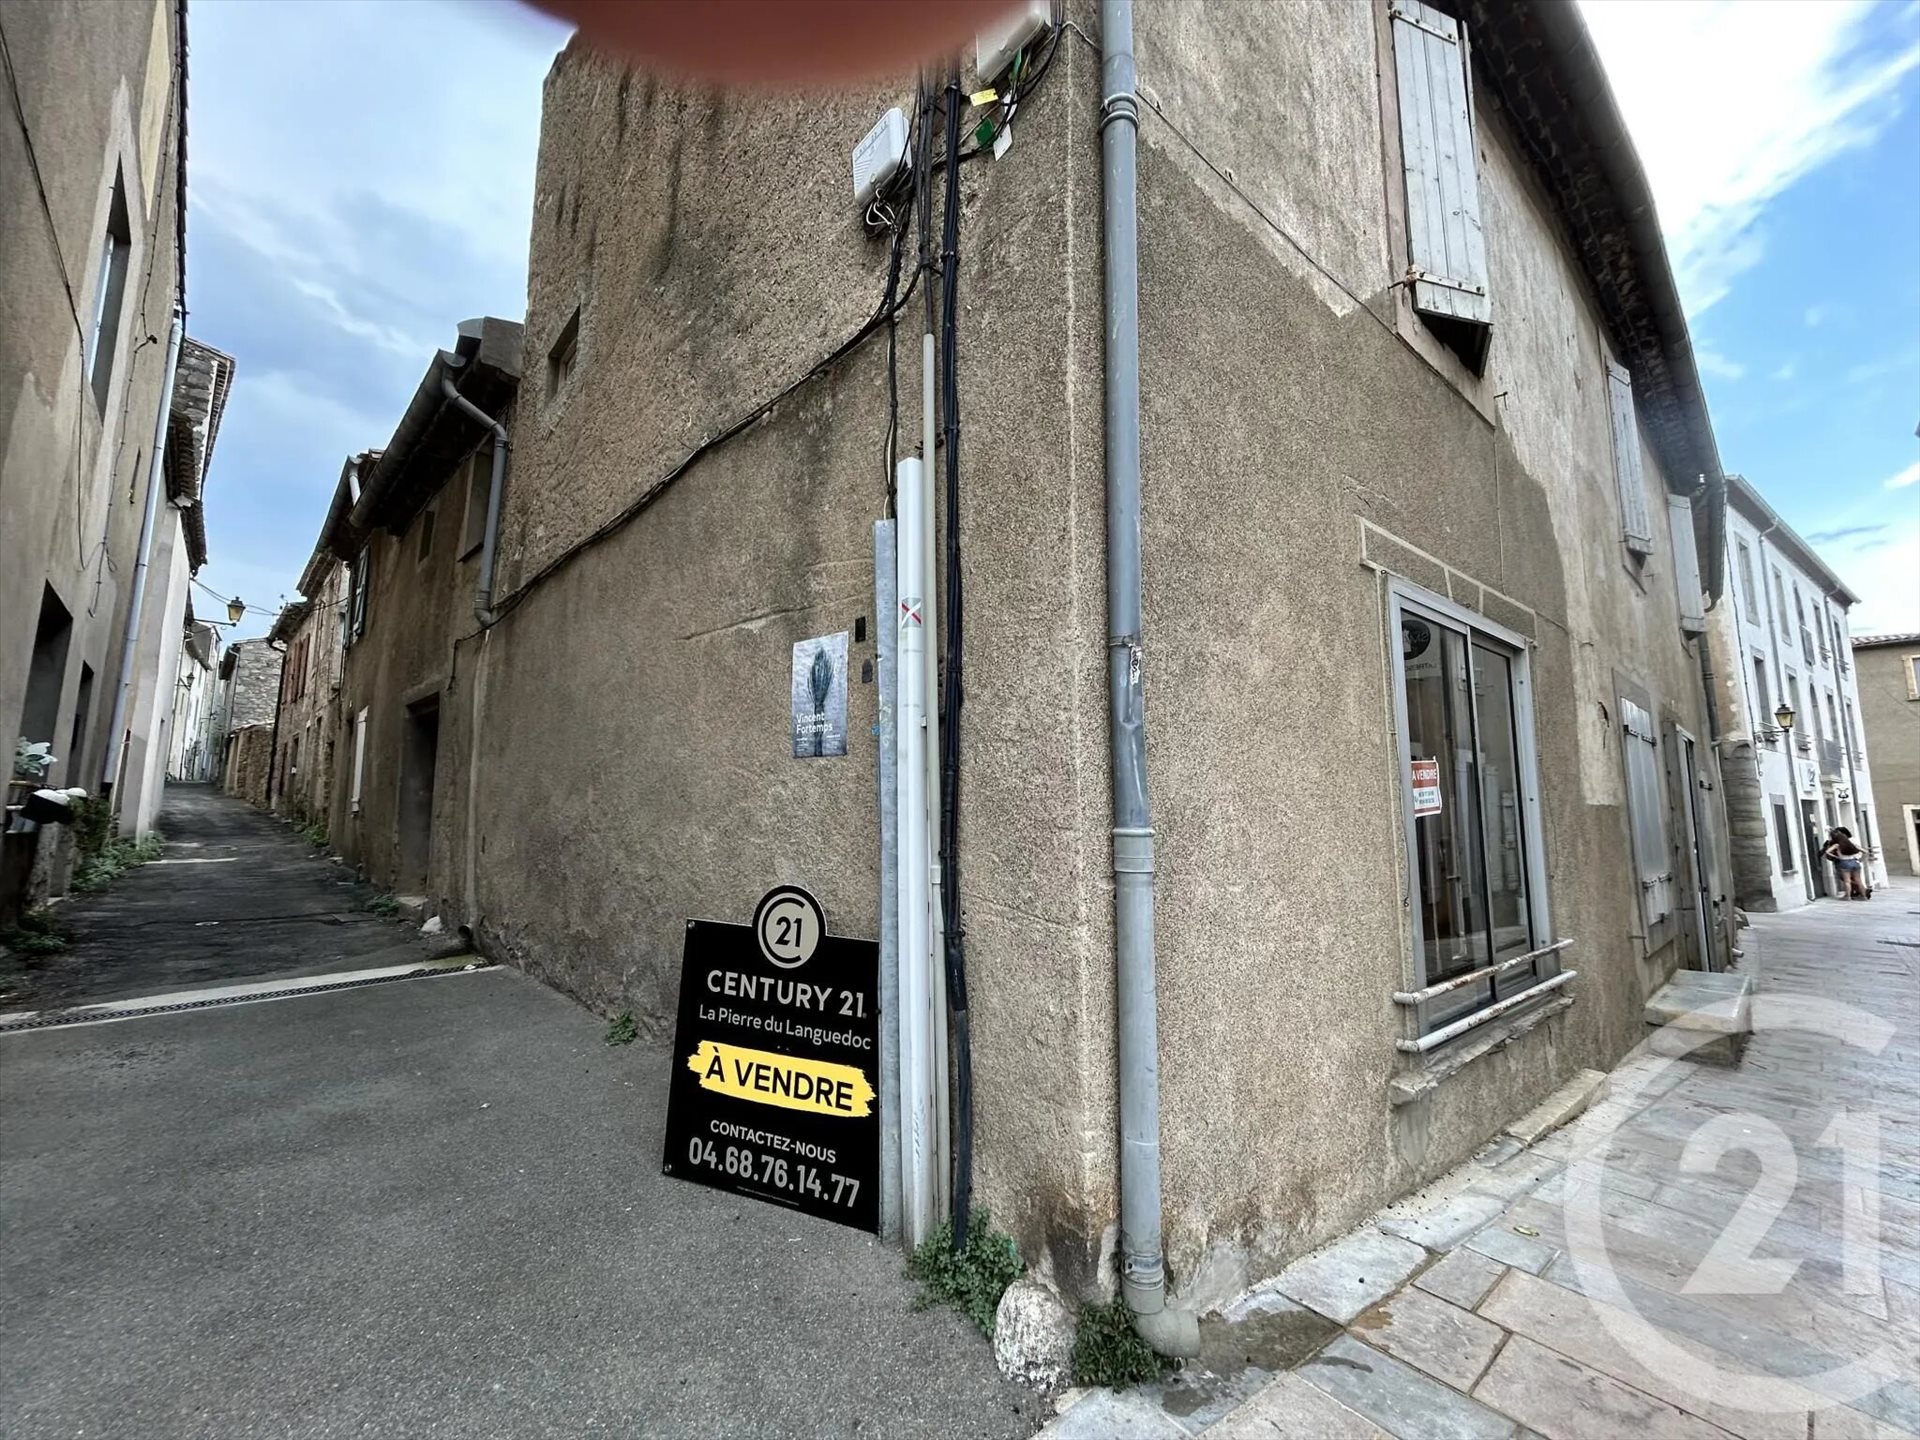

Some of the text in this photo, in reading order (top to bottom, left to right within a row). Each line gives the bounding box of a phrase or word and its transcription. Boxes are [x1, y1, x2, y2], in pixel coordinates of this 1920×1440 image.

[796, 711, 825, 723] Vincent
[796, 723, 833, 735] Fortemps
[706, 969, 864, 1017] CENTURY 21
[699, 1004, 872, 1050] La Pierre du Languedoc
[705, 1046, 854, 1111] À VENDRE
[710, 1119, 837, 1164] CONTACTEZ-NOUS
[688, 1136, 860, 1208] 04.68.76.14.77
